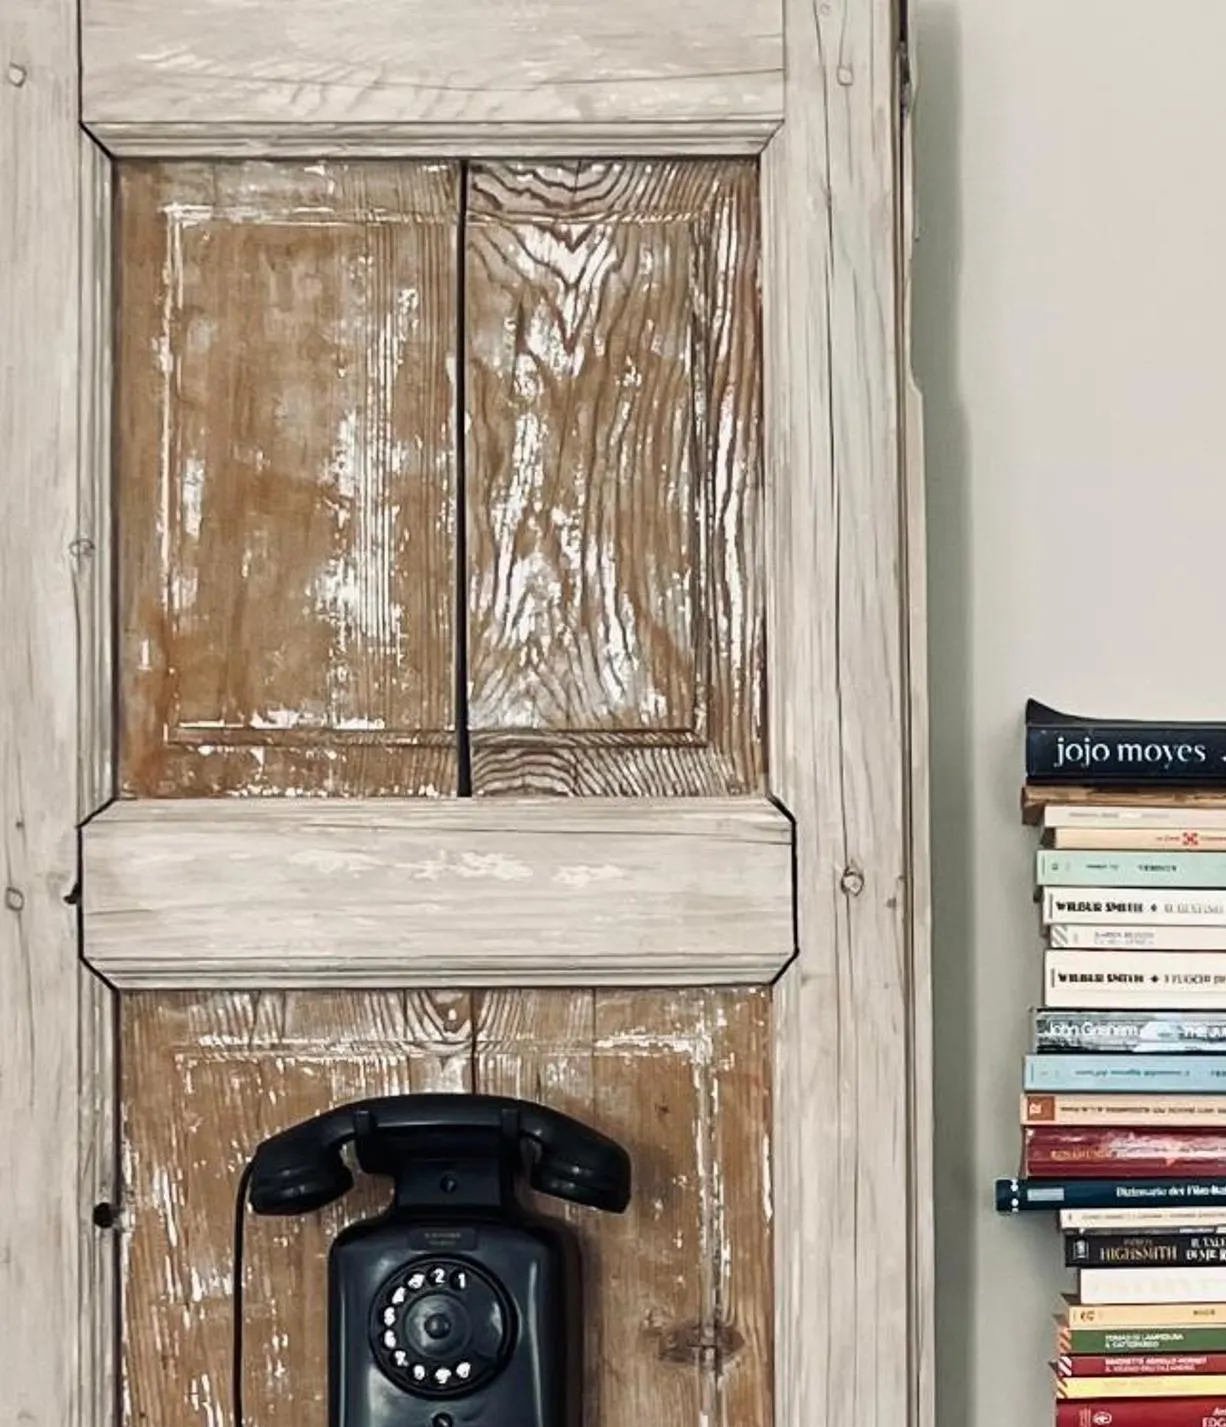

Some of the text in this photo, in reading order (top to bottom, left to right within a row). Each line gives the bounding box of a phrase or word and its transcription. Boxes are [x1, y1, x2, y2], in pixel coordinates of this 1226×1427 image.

[1054, 737, 1206, 767] jojo moyes
[1056, 901, 1102, 912] WILBUR
[1105, 901, 1143, 912] SMITH
[1058, 973, 1104, 983] WILBUR
[1107, 973, 1145, 983] SMITH
[1100, 1245, 1177, 1261] HIGHSMITH
